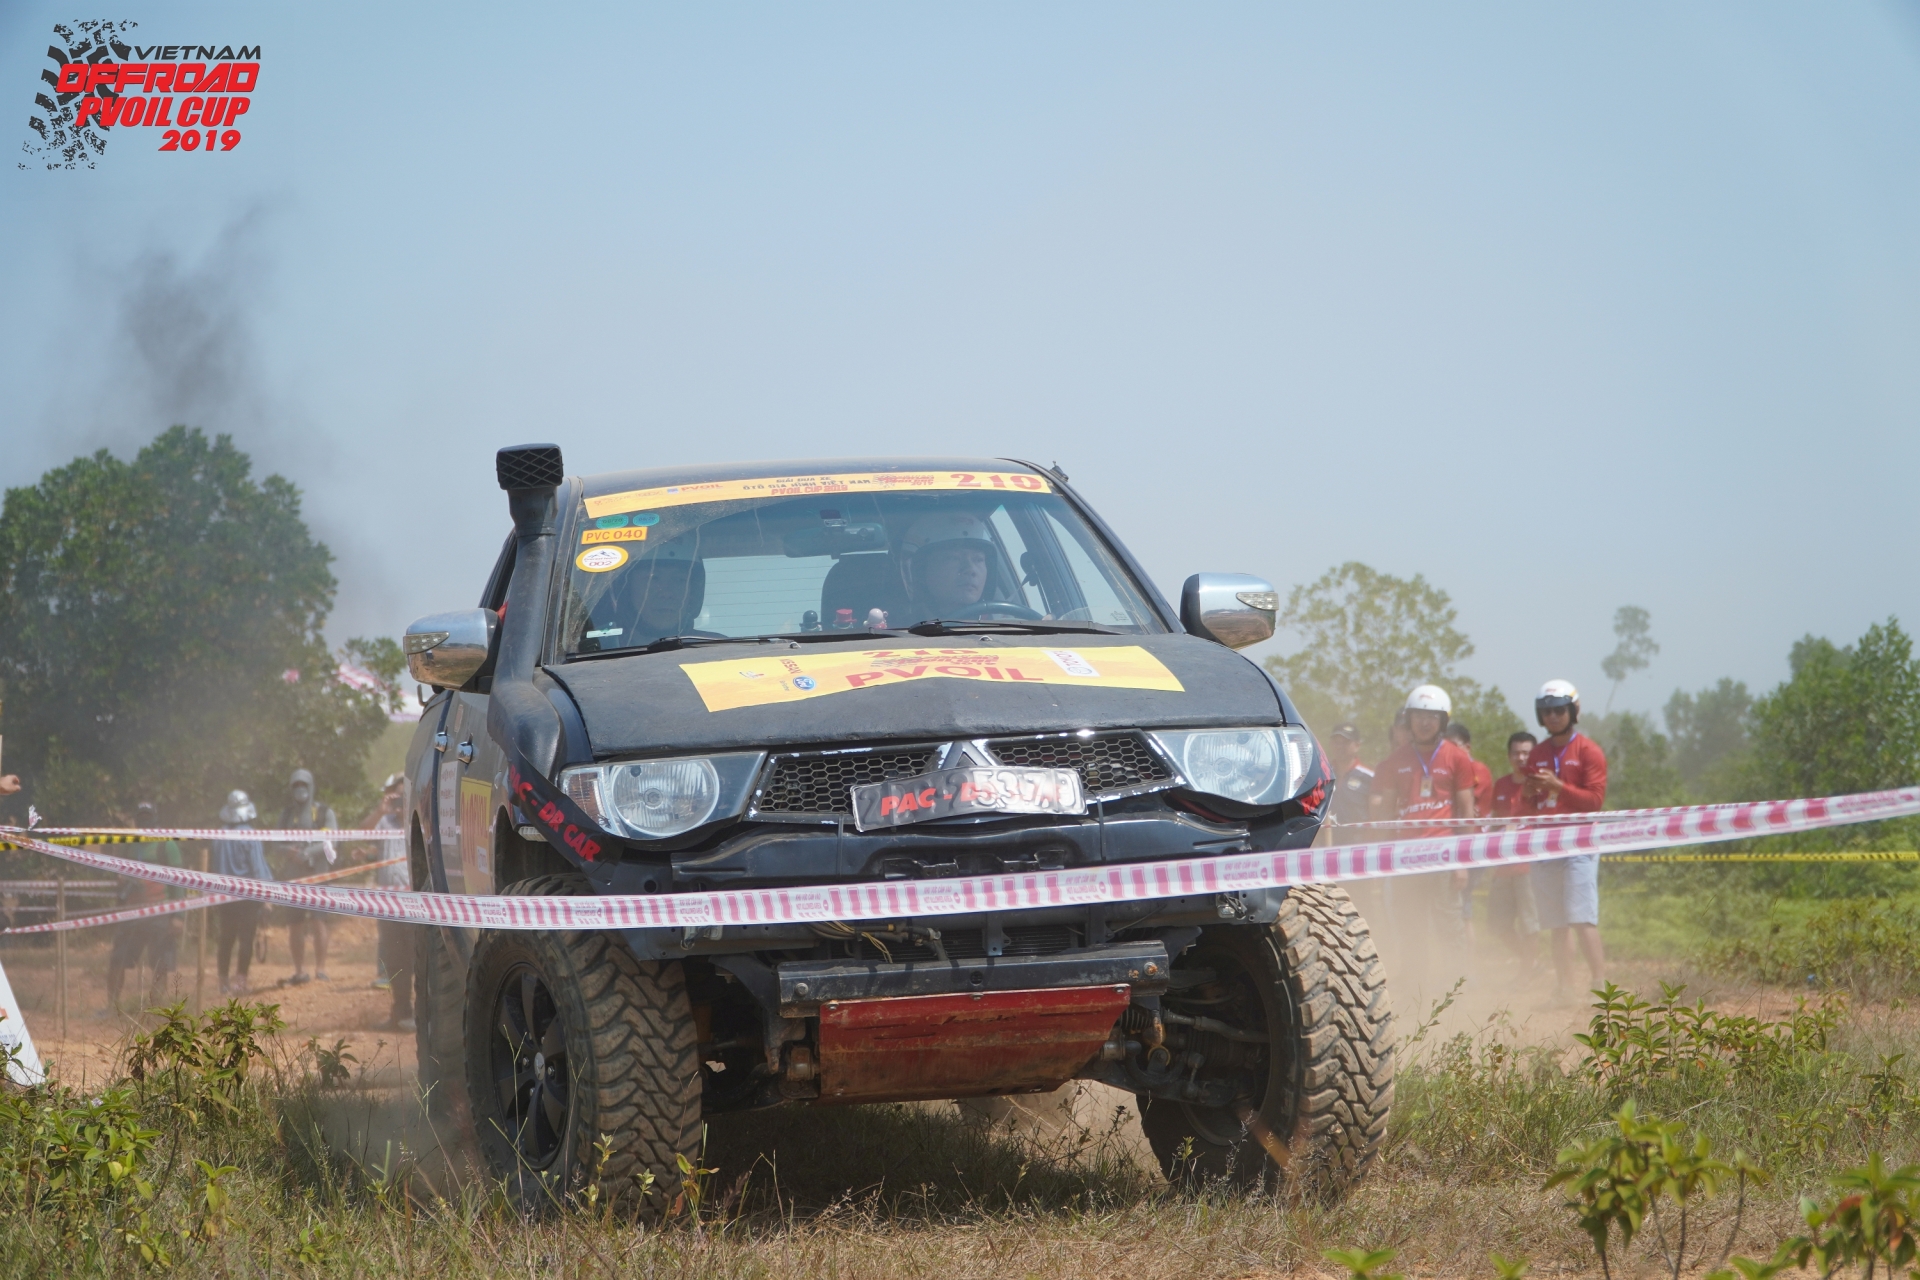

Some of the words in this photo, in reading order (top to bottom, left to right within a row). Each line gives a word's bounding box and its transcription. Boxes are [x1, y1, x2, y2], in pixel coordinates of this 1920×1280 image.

[681, 483, 723, 491] PVOIL
[950, 473, 1042, 491] 210
[771, 486, 803, 495] PVOIL
[804, 485, 823, 494] CUP
[586, 531, 610, 542] PVC
[613, 529, 643, 540] 040
[862, 649, 978, 658] 210
[845, 665, 1044, 688] PVOIL
[880, 787, 936, 817] PAC
[538, 801, 565, 833] DR
[563, 824, 601, 862] CAR
